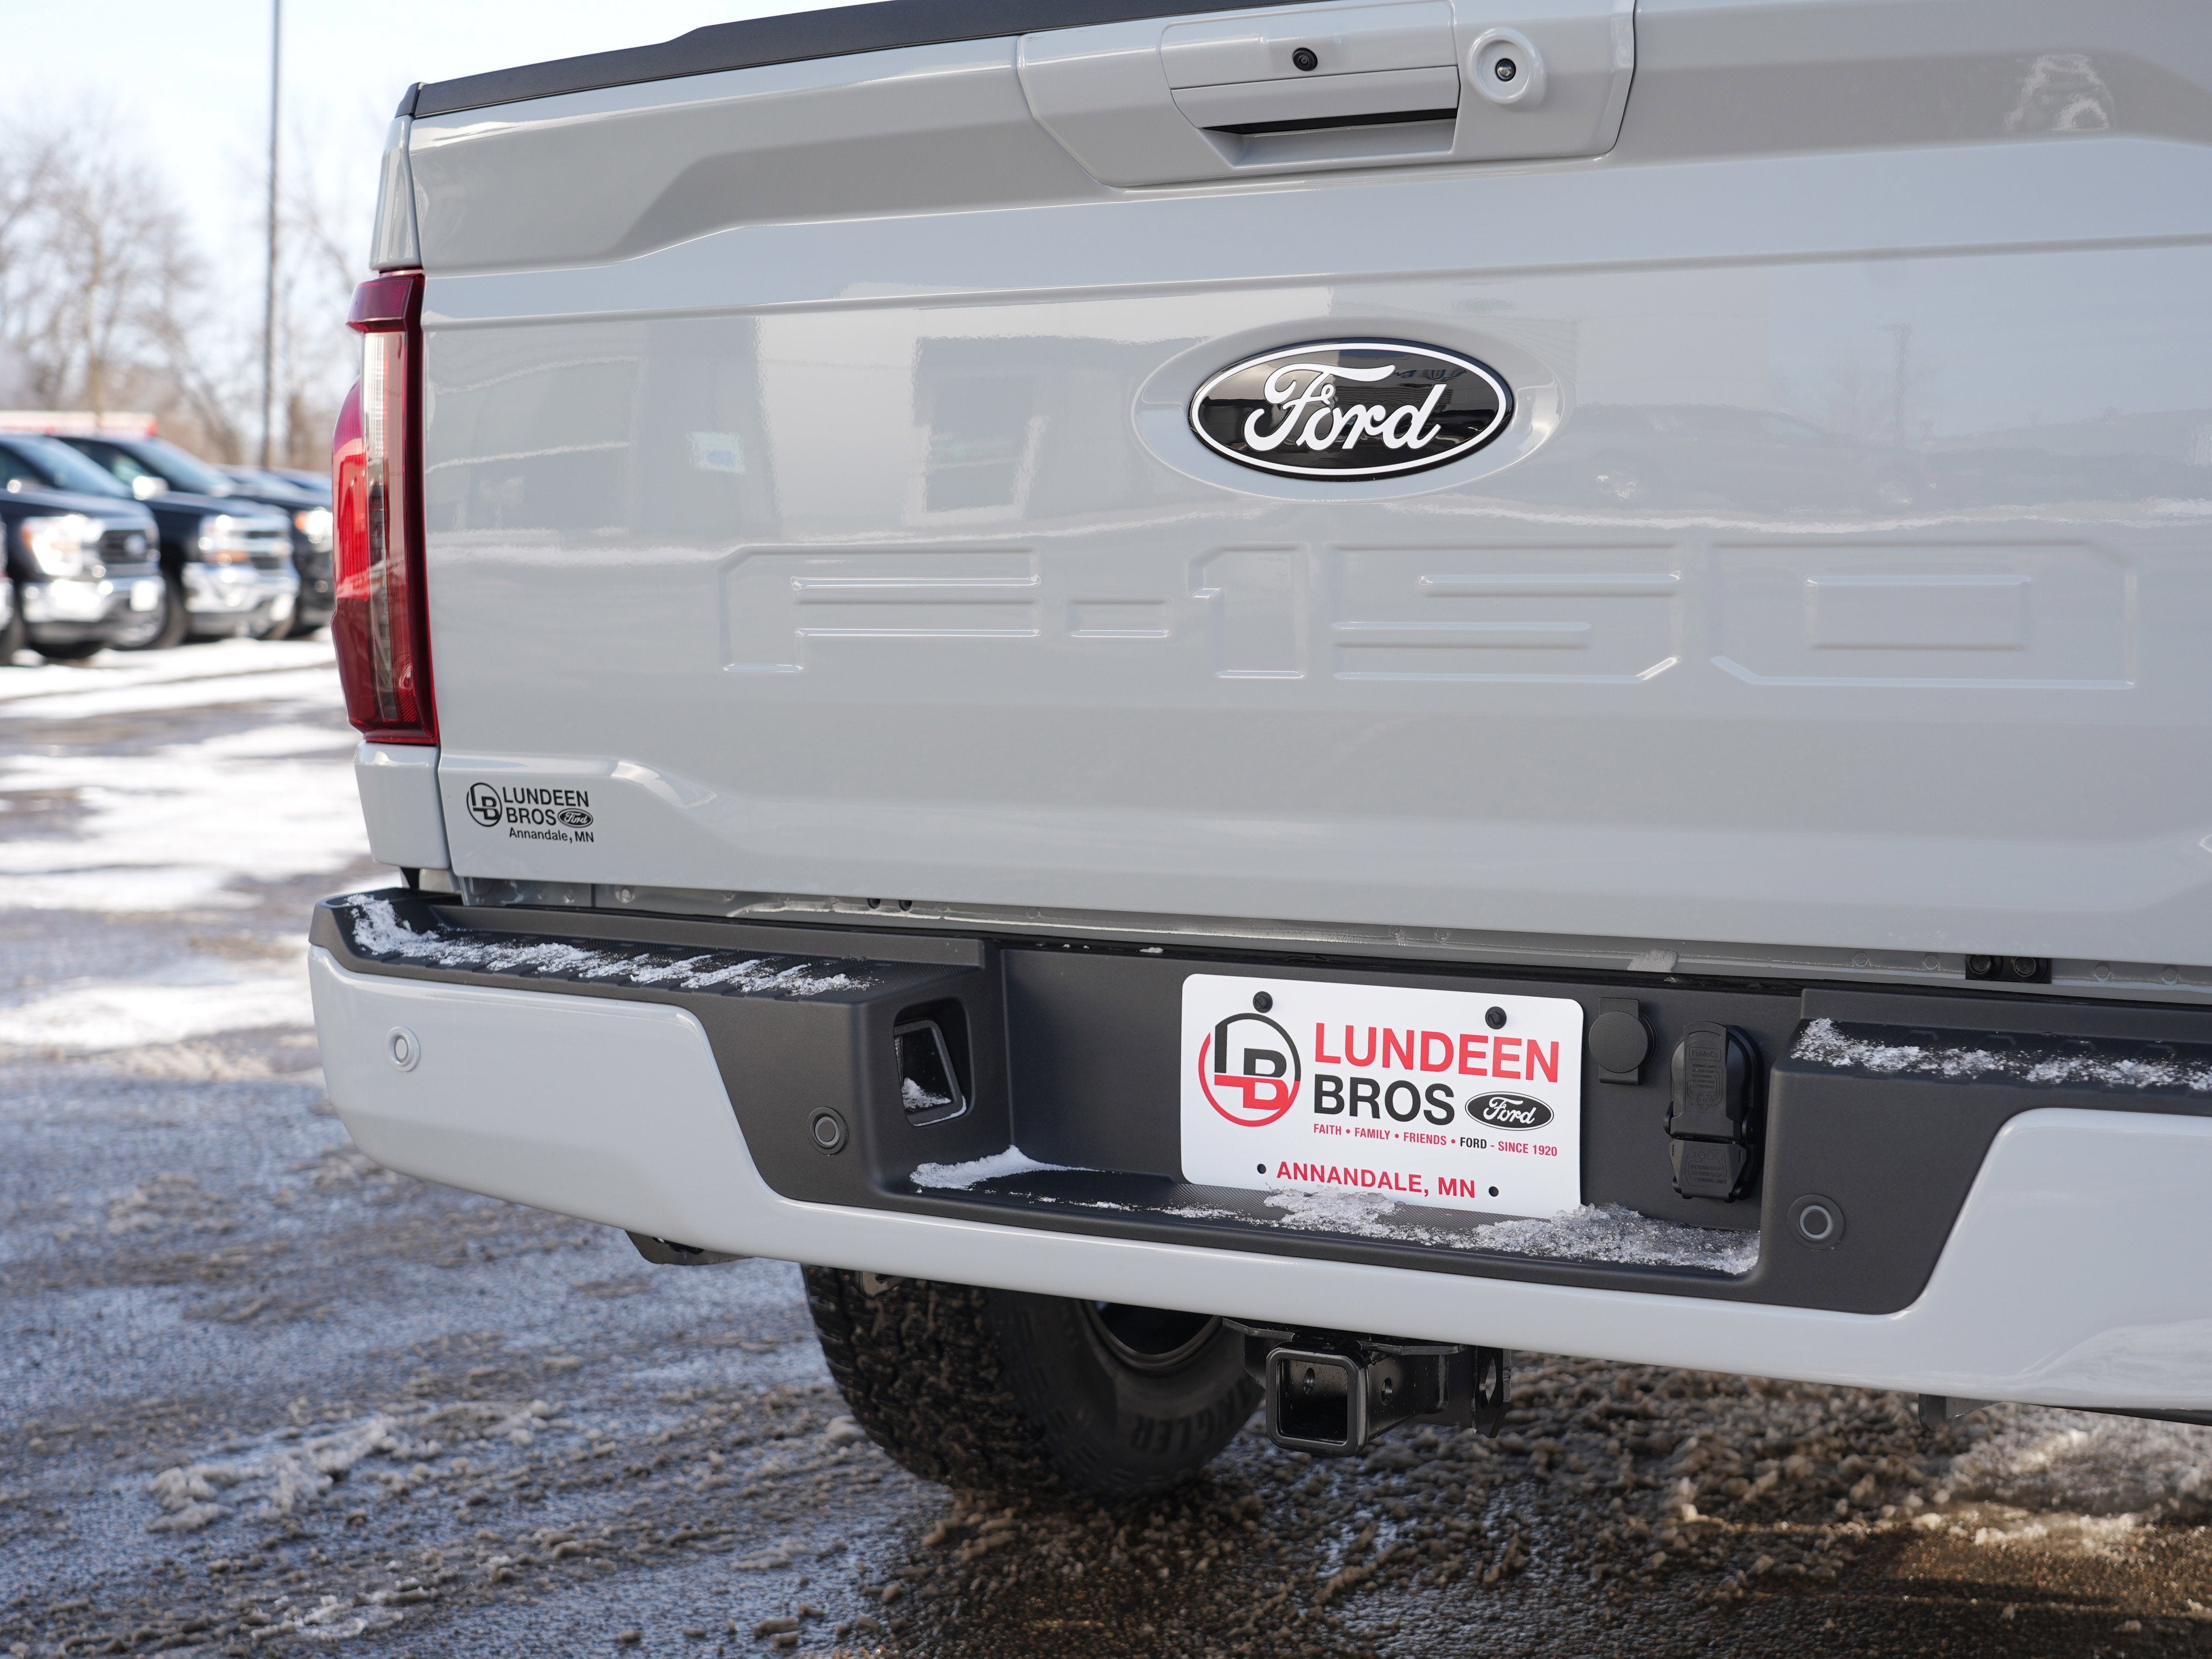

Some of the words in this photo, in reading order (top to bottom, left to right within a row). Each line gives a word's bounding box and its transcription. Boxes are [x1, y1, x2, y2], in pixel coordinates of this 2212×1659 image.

[1244, 362, 1447, 451] Ford
[720, 540, 2137, 690] F-150
[503, 787, 589, 807] LUNDEEN
[506, 807, 556, 825] BROS
[509, 827, 572, 844] Annandale,
[575, 831, 594, 842] MN
[1314, 1023, 1559, 1083] LUNDEEN
[1314, 1074, 1455, 1126] BROS
[1313, 1124, 1341, 1135] FAITH
[1354, 1128, 1390, 1139] FAMILY
[1404, 1131, 1447, 1145] FRIENDS
[1460, 1137, 1487, 1149] FORD
[1498, 1141, 1529, 1154] SINCE
[1533, 1144, 1557, 1156] 1920
[1277, 1161, 1429, 1197] ANNANDALE,
[1438, 1177, 1475, 1198] MN
